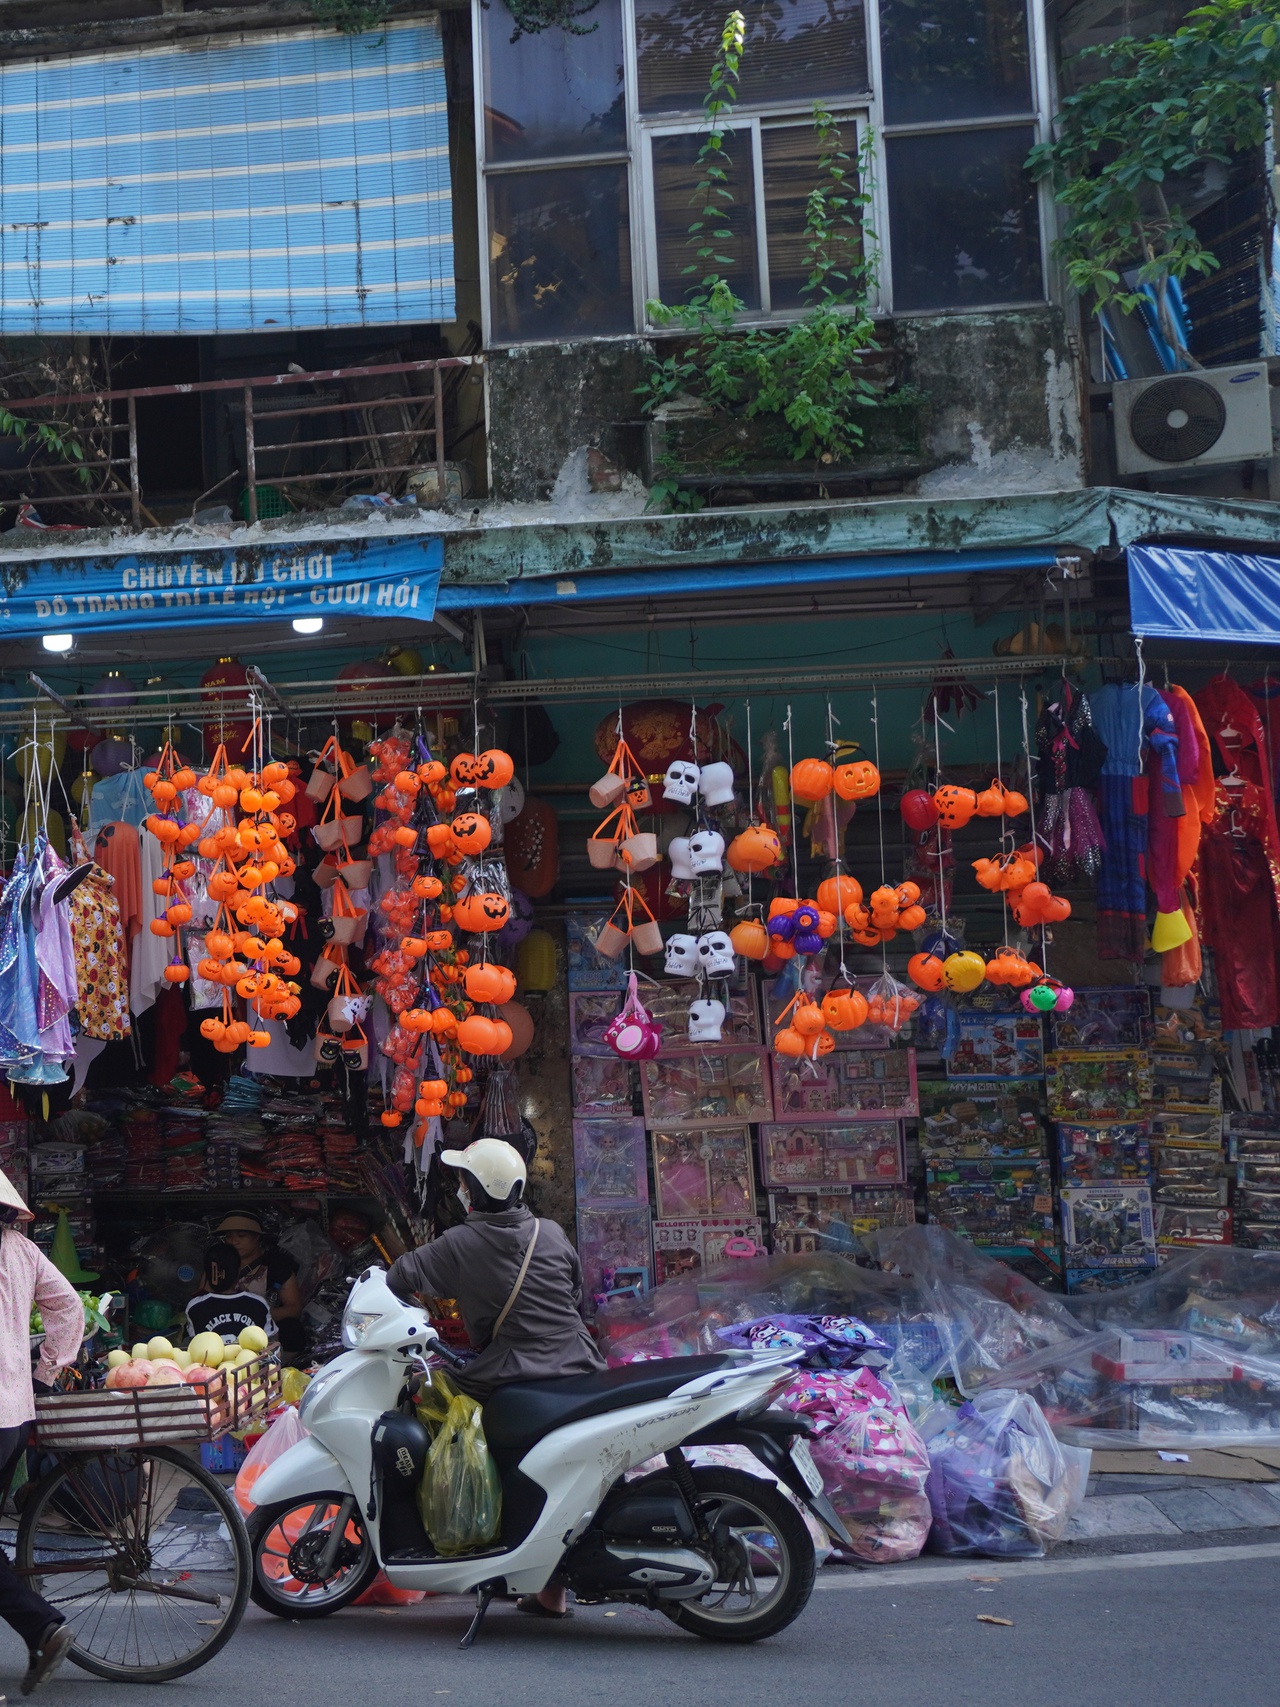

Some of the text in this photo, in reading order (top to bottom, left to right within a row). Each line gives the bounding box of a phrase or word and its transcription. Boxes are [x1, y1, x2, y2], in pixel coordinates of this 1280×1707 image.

[273, 553, 333, 582] CHƠI
[73, 592, 155, 614] TRANG
[376, 577, 420, 609] HỎI
[205, 1313, 232, 1332] BLACK
